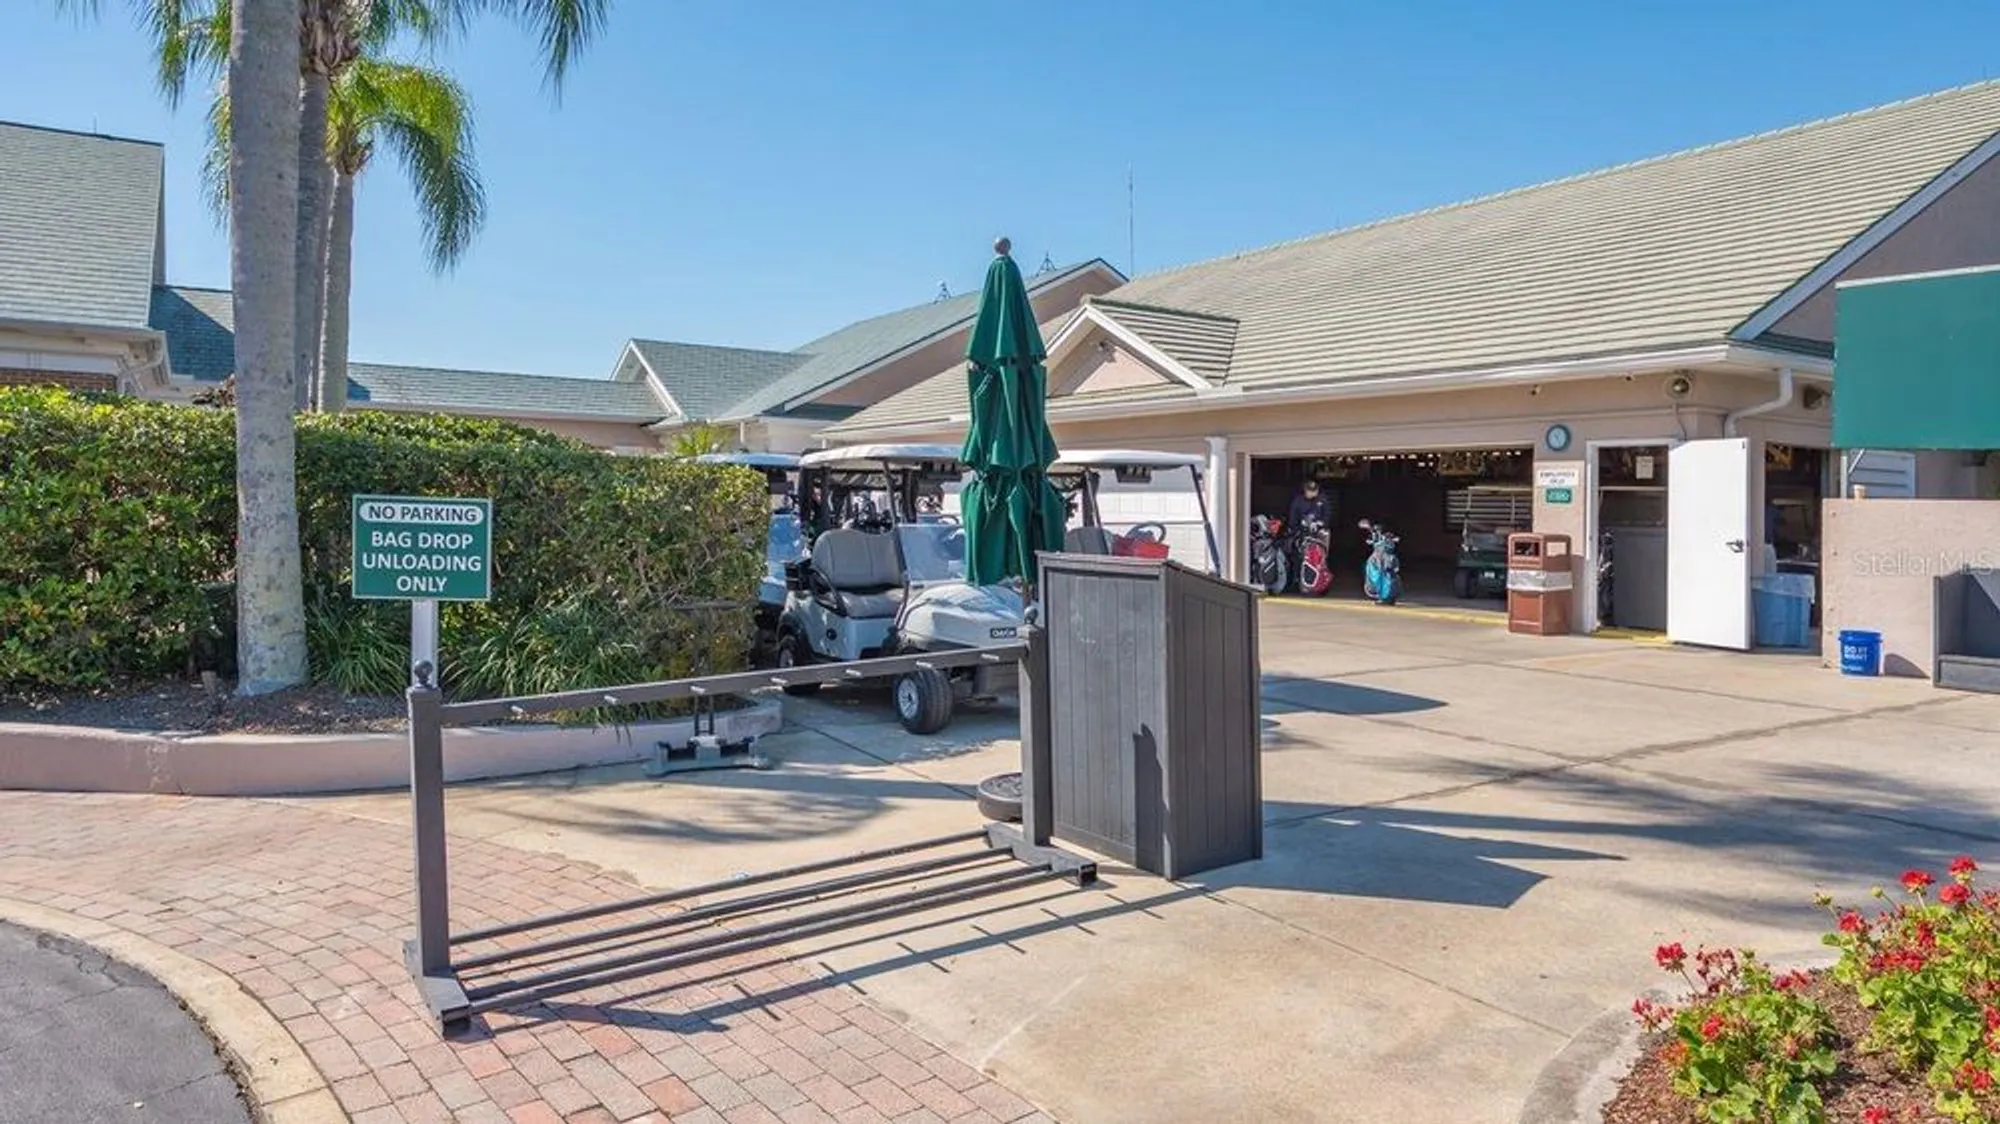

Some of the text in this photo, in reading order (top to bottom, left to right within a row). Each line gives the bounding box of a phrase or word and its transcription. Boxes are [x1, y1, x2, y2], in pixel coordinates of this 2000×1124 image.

[368, 505, 477, 522] NO PARKING
[371, 531, 474, 549] BAG DROP
[362, 553, 482, 571] UNLOADING
[396, 575, 448, 592] ONLY
